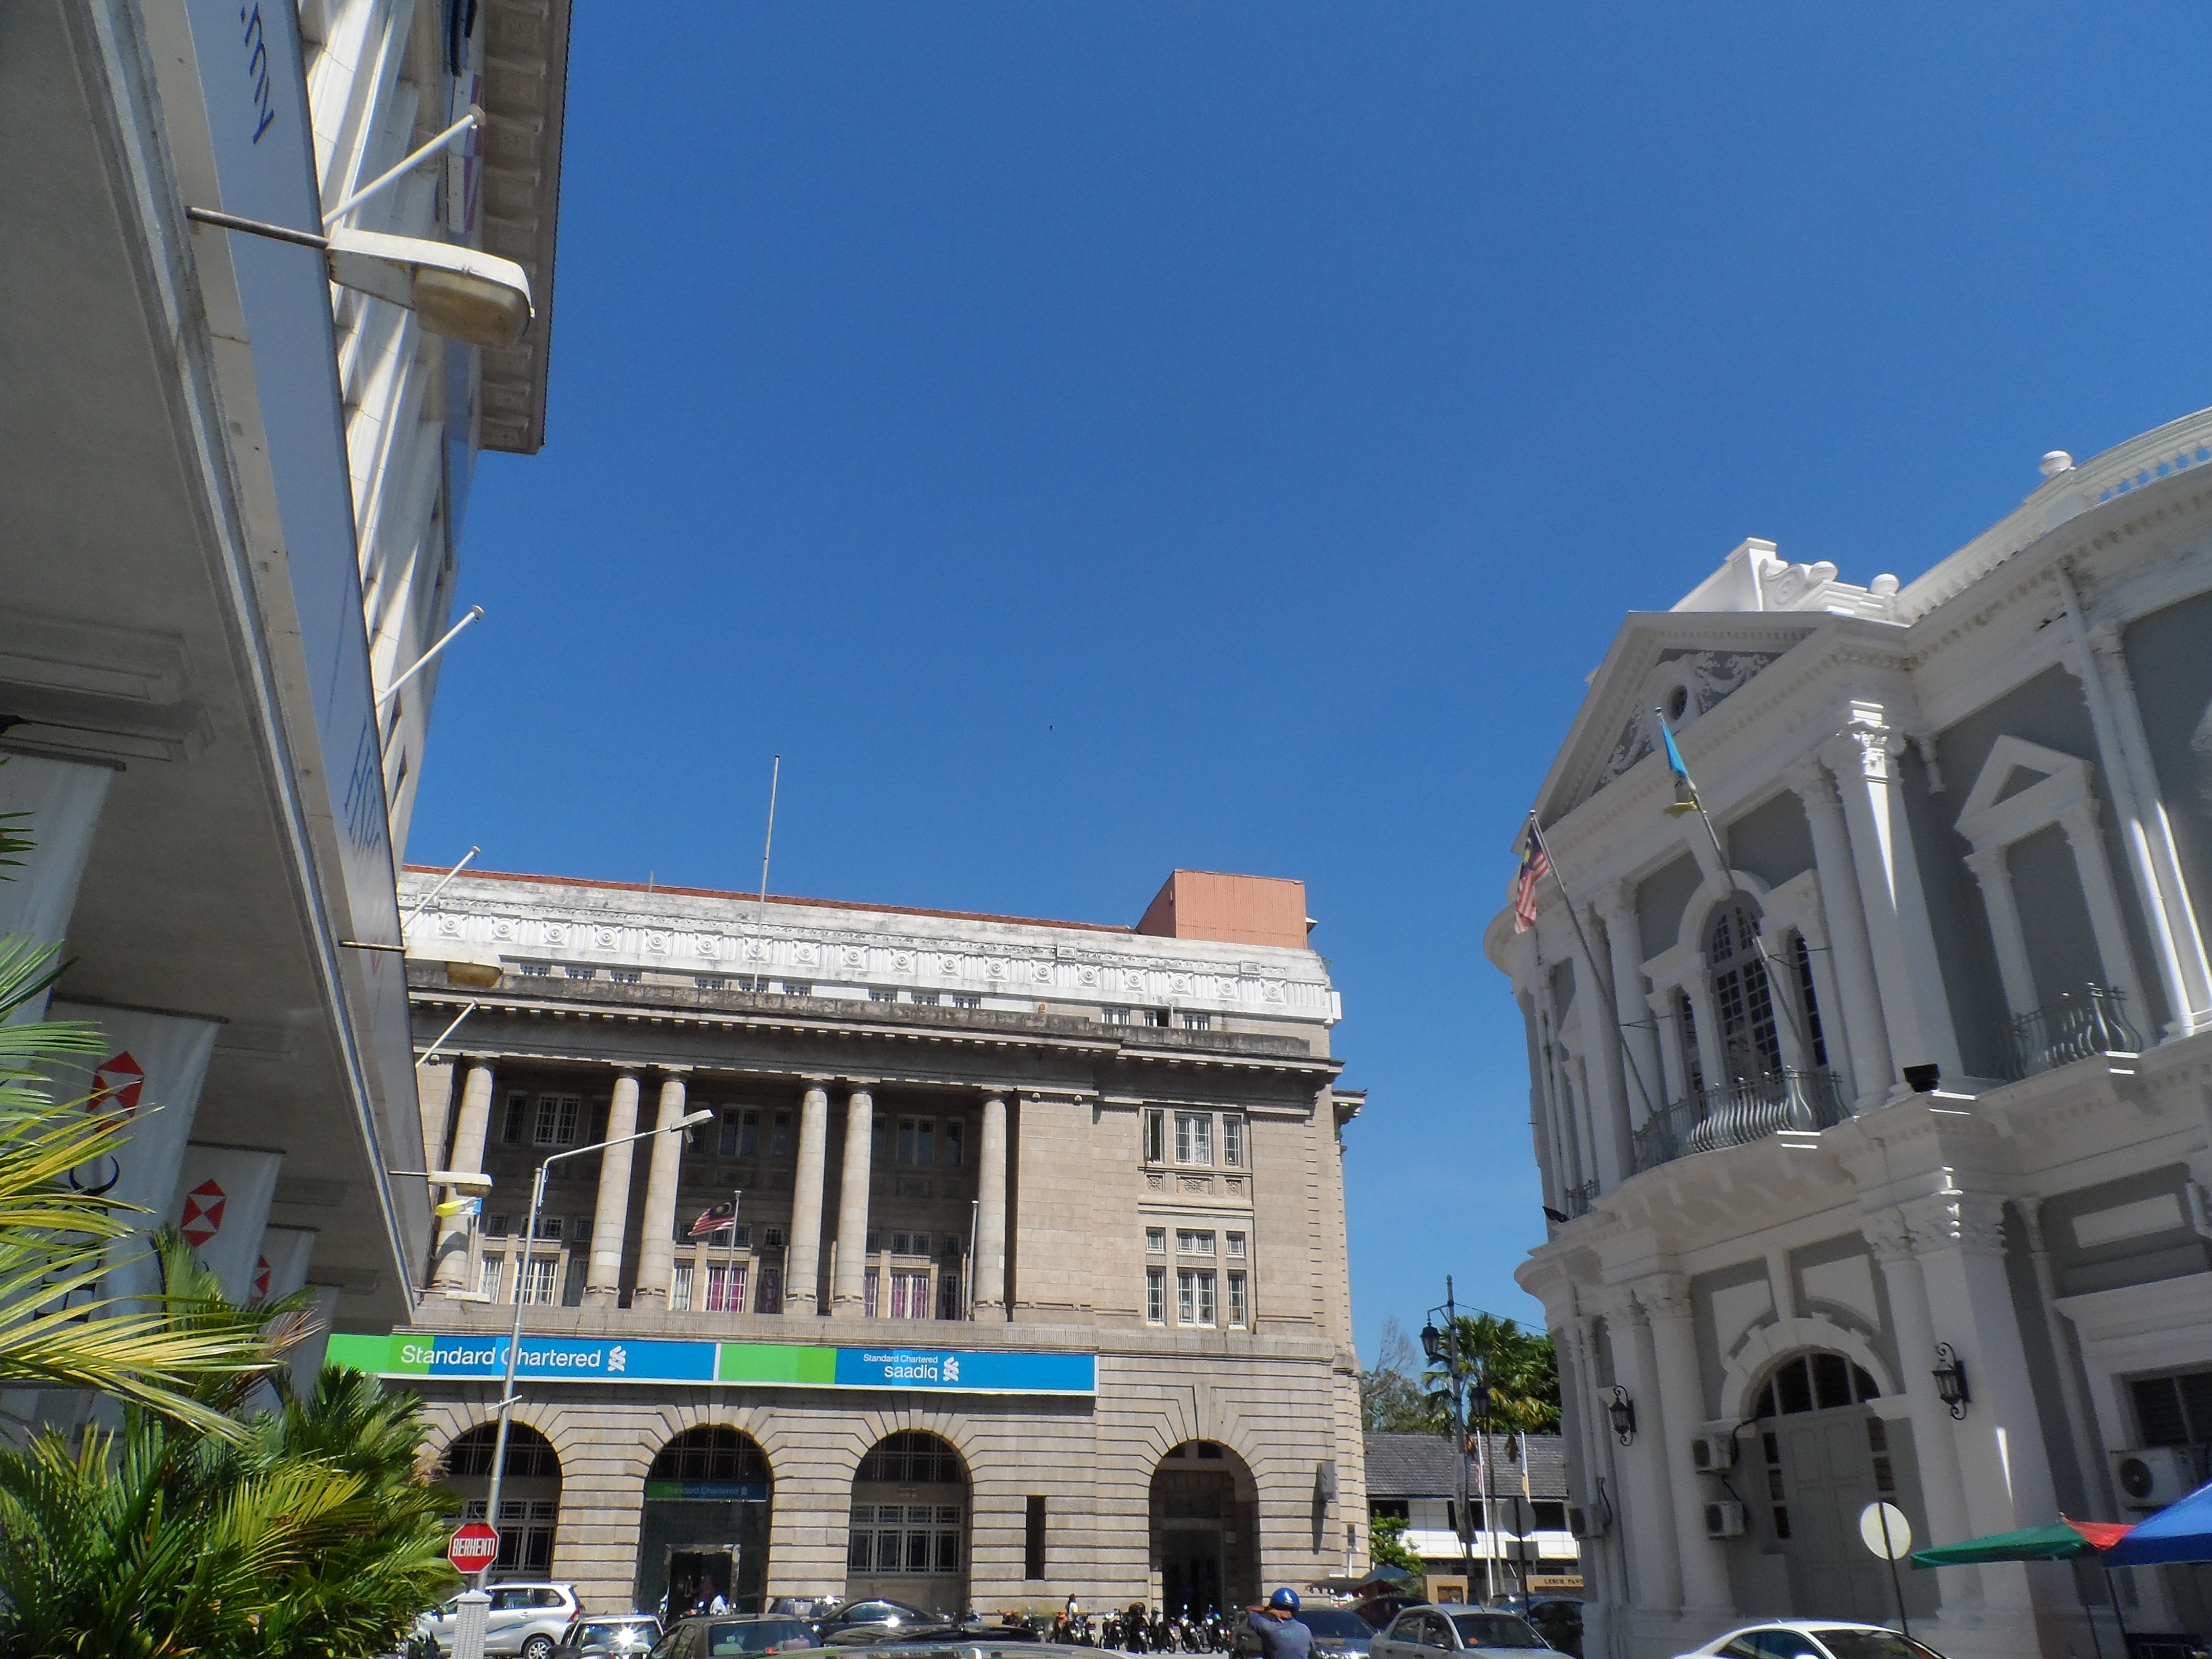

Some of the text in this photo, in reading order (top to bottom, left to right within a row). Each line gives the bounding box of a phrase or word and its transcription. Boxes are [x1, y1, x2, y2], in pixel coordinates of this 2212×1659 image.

[401, 1345, 495, 1365] Standard
[863, 1354, 938, 1363] Standard Chartered
[884, 1365, 938, 1381] saadiq
[701, 1486, 739, 1495] Chartered
[452, 1538, 496, 1557] BERHENTI
